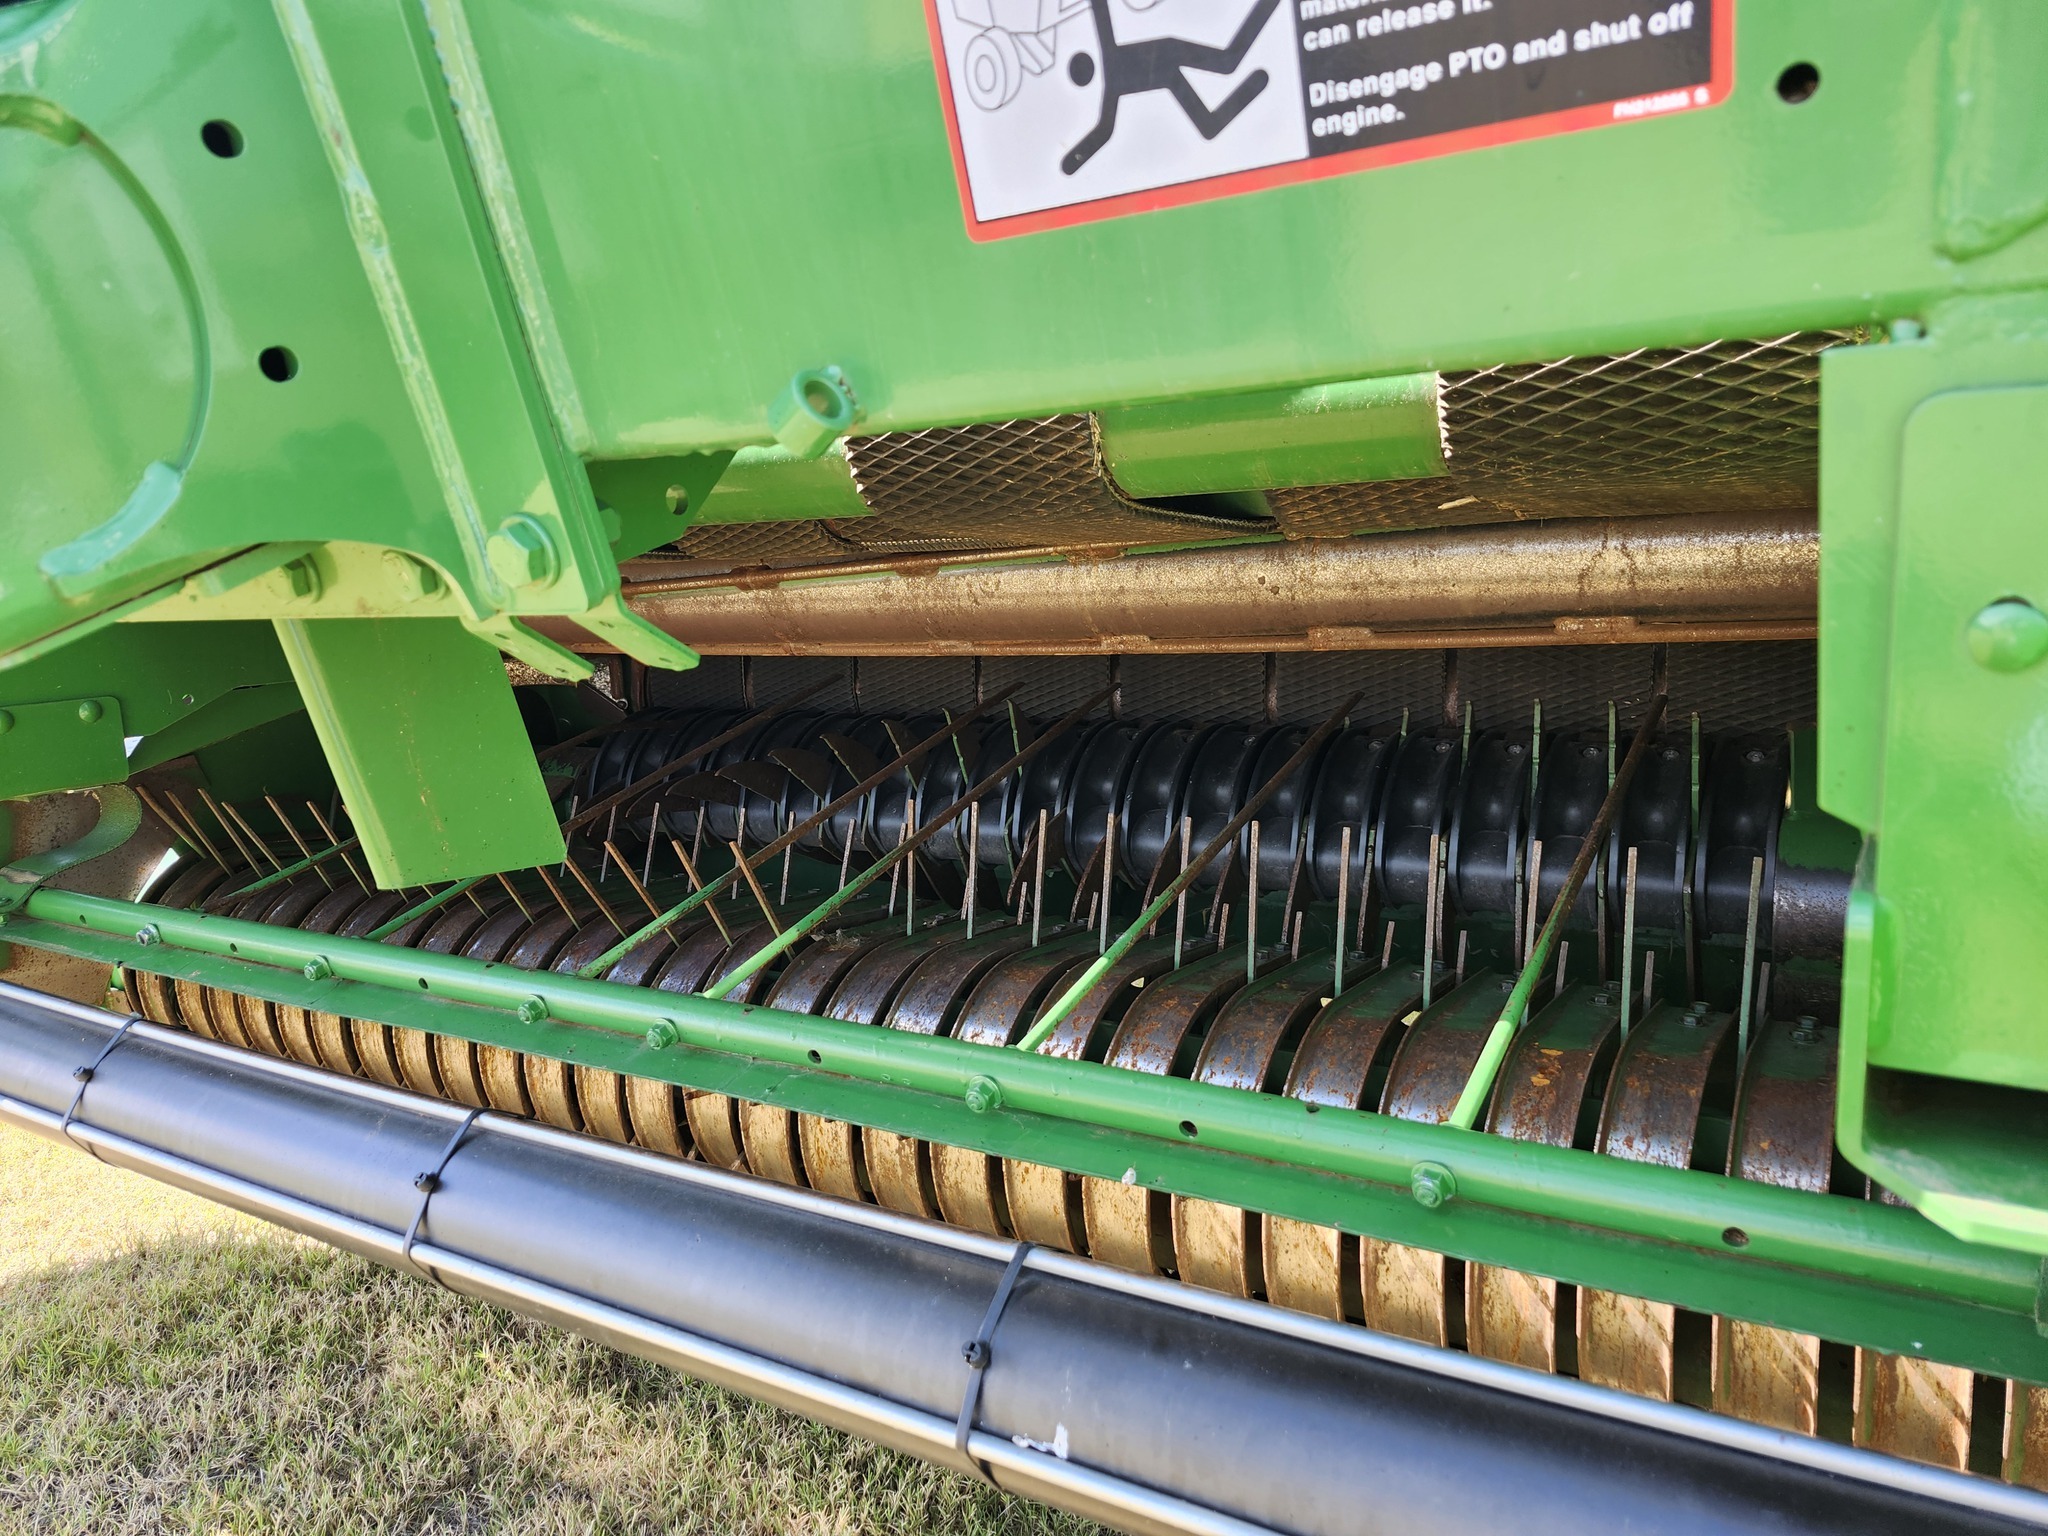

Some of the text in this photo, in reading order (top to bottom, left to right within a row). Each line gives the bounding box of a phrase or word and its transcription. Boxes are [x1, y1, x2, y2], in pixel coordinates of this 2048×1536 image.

[1303, 23, 1351, 51] can
[1356, 0, 1457, 40] release
[1309, 0, 1694, 108] Disengage PTO and shut off
[1311, 102, 1406, 137] engine.
